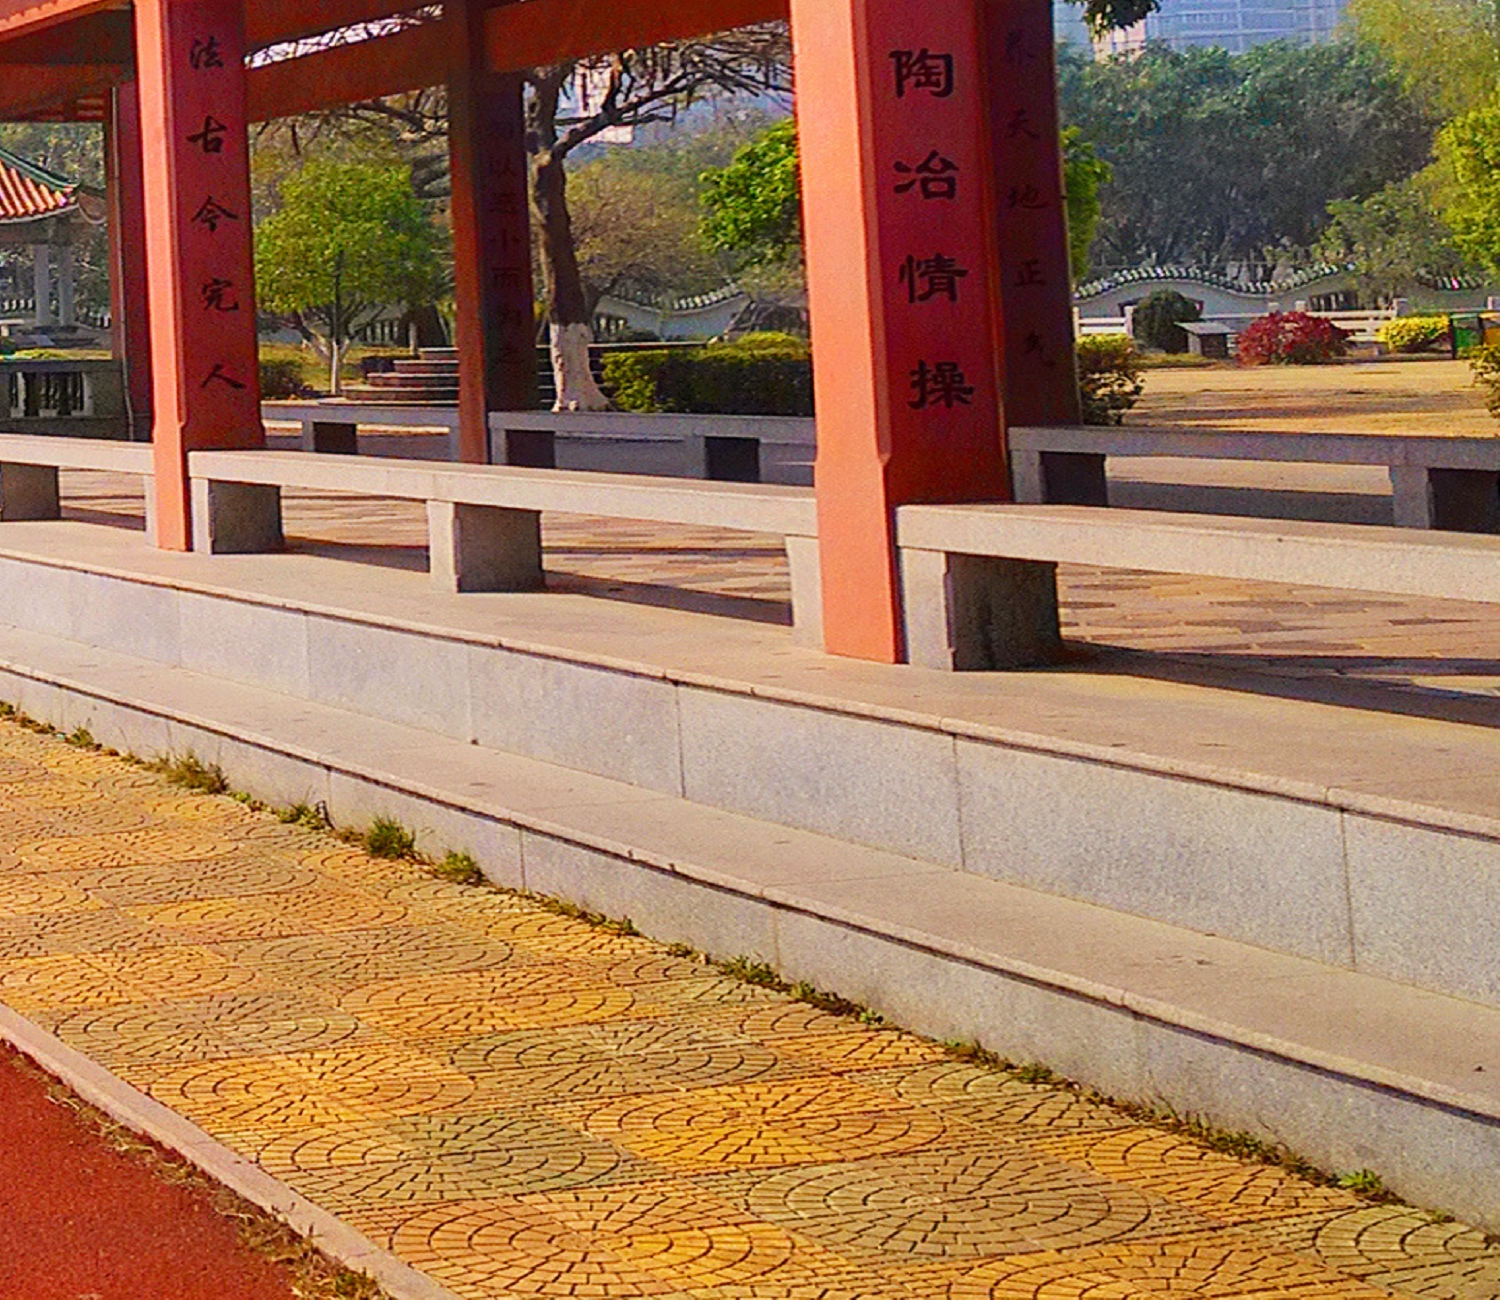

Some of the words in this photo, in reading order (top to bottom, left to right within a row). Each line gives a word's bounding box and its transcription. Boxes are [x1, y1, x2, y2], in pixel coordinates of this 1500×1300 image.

[185, 35, 247, 390] 法古今完人
